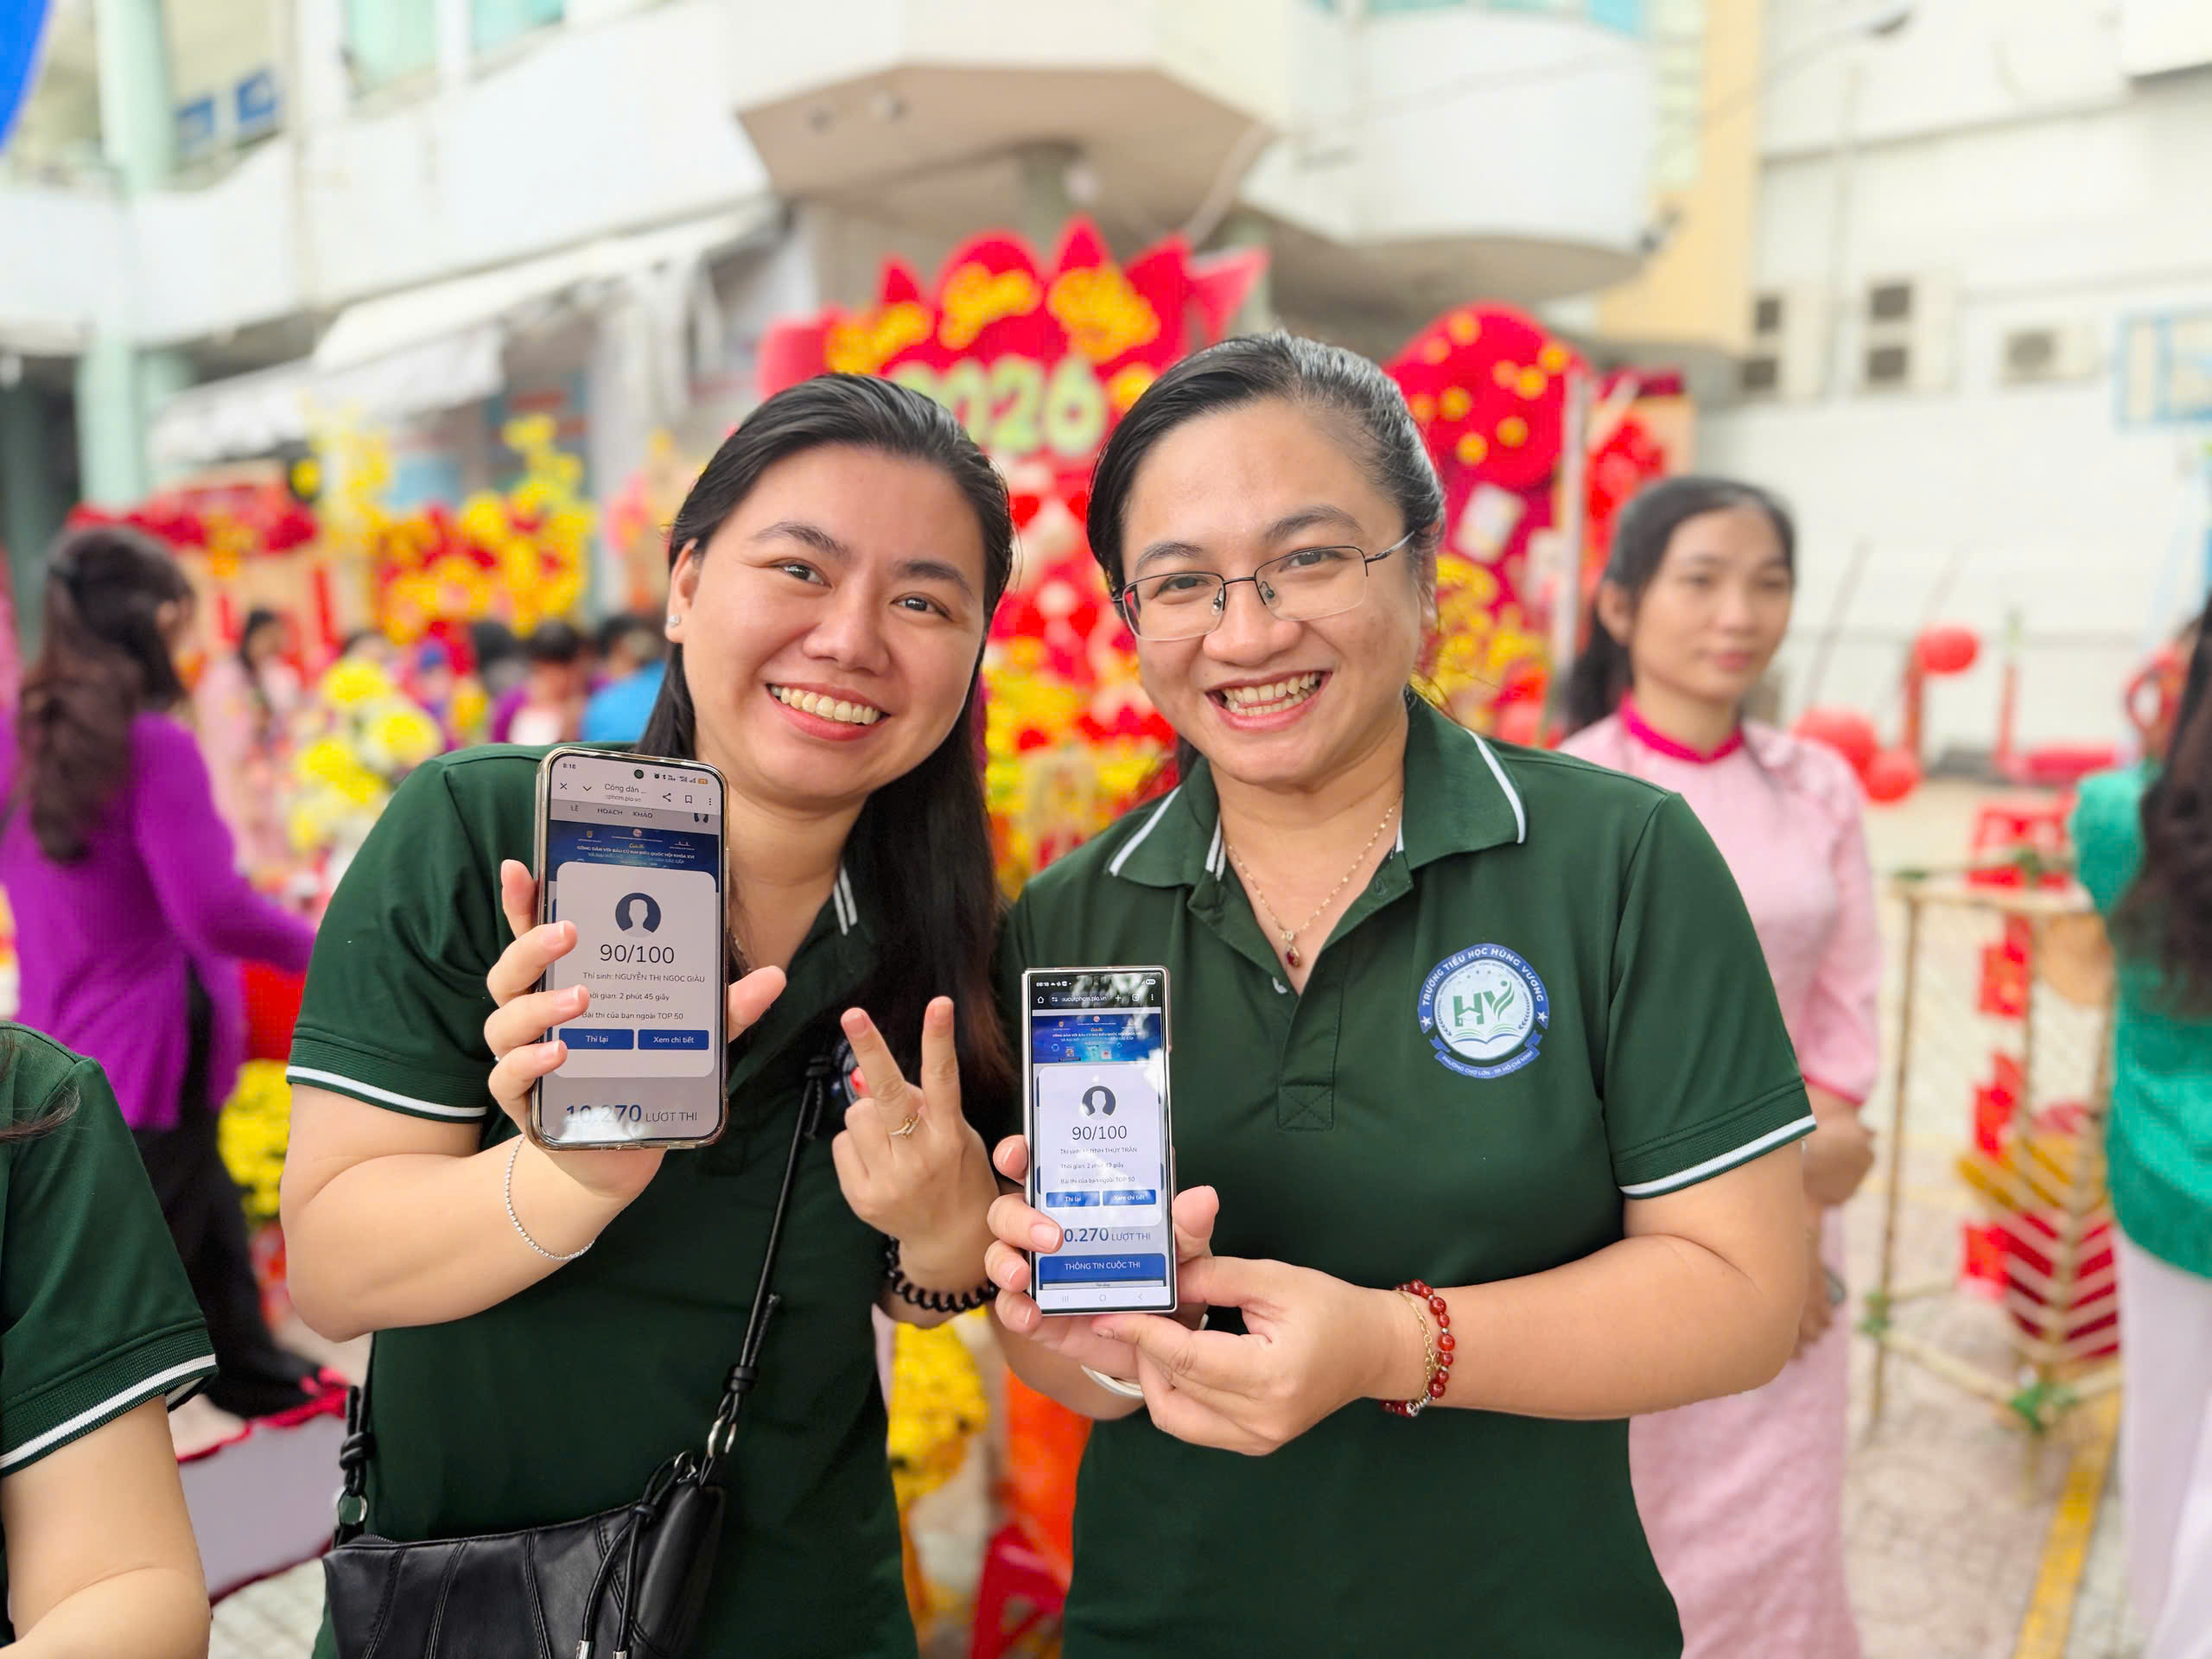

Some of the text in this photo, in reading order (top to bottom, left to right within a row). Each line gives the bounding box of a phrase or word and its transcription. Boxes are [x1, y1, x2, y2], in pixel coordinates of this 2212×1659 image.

[890, 357, 1109, 456] 026
[605, 783, 624, 793] Công
[626, 785, 639, 793] dân
[600, 944, 675, 964] 90/100
[614, 972, 647, 982] NGUYỄN
[687, 974, 705, 983] GIÀU
[1421, 969, 1445, 1006] TRƯỜNG
[1443, 954, 1465, 971] TIỂU
[1467, 946, 1488, 958] HỌC
[1491, 947, 1521, 967] HÙNG
[1521, 965, 1544, 1002] VƯƠNG
[655, 994, 670, 1002] giây
[599, 1035, 608, 1045] lại
[678, 1111, 697, 1122] THI
[1072, 1125, 1128, 1141] 90/100
[1064, 1228, 1151, 1242] 0.270 LƯỢT THI
[1065, 1260, 1091, 1270] THÔNG
[1106, 1260, 1127, 1270] CUỘC
